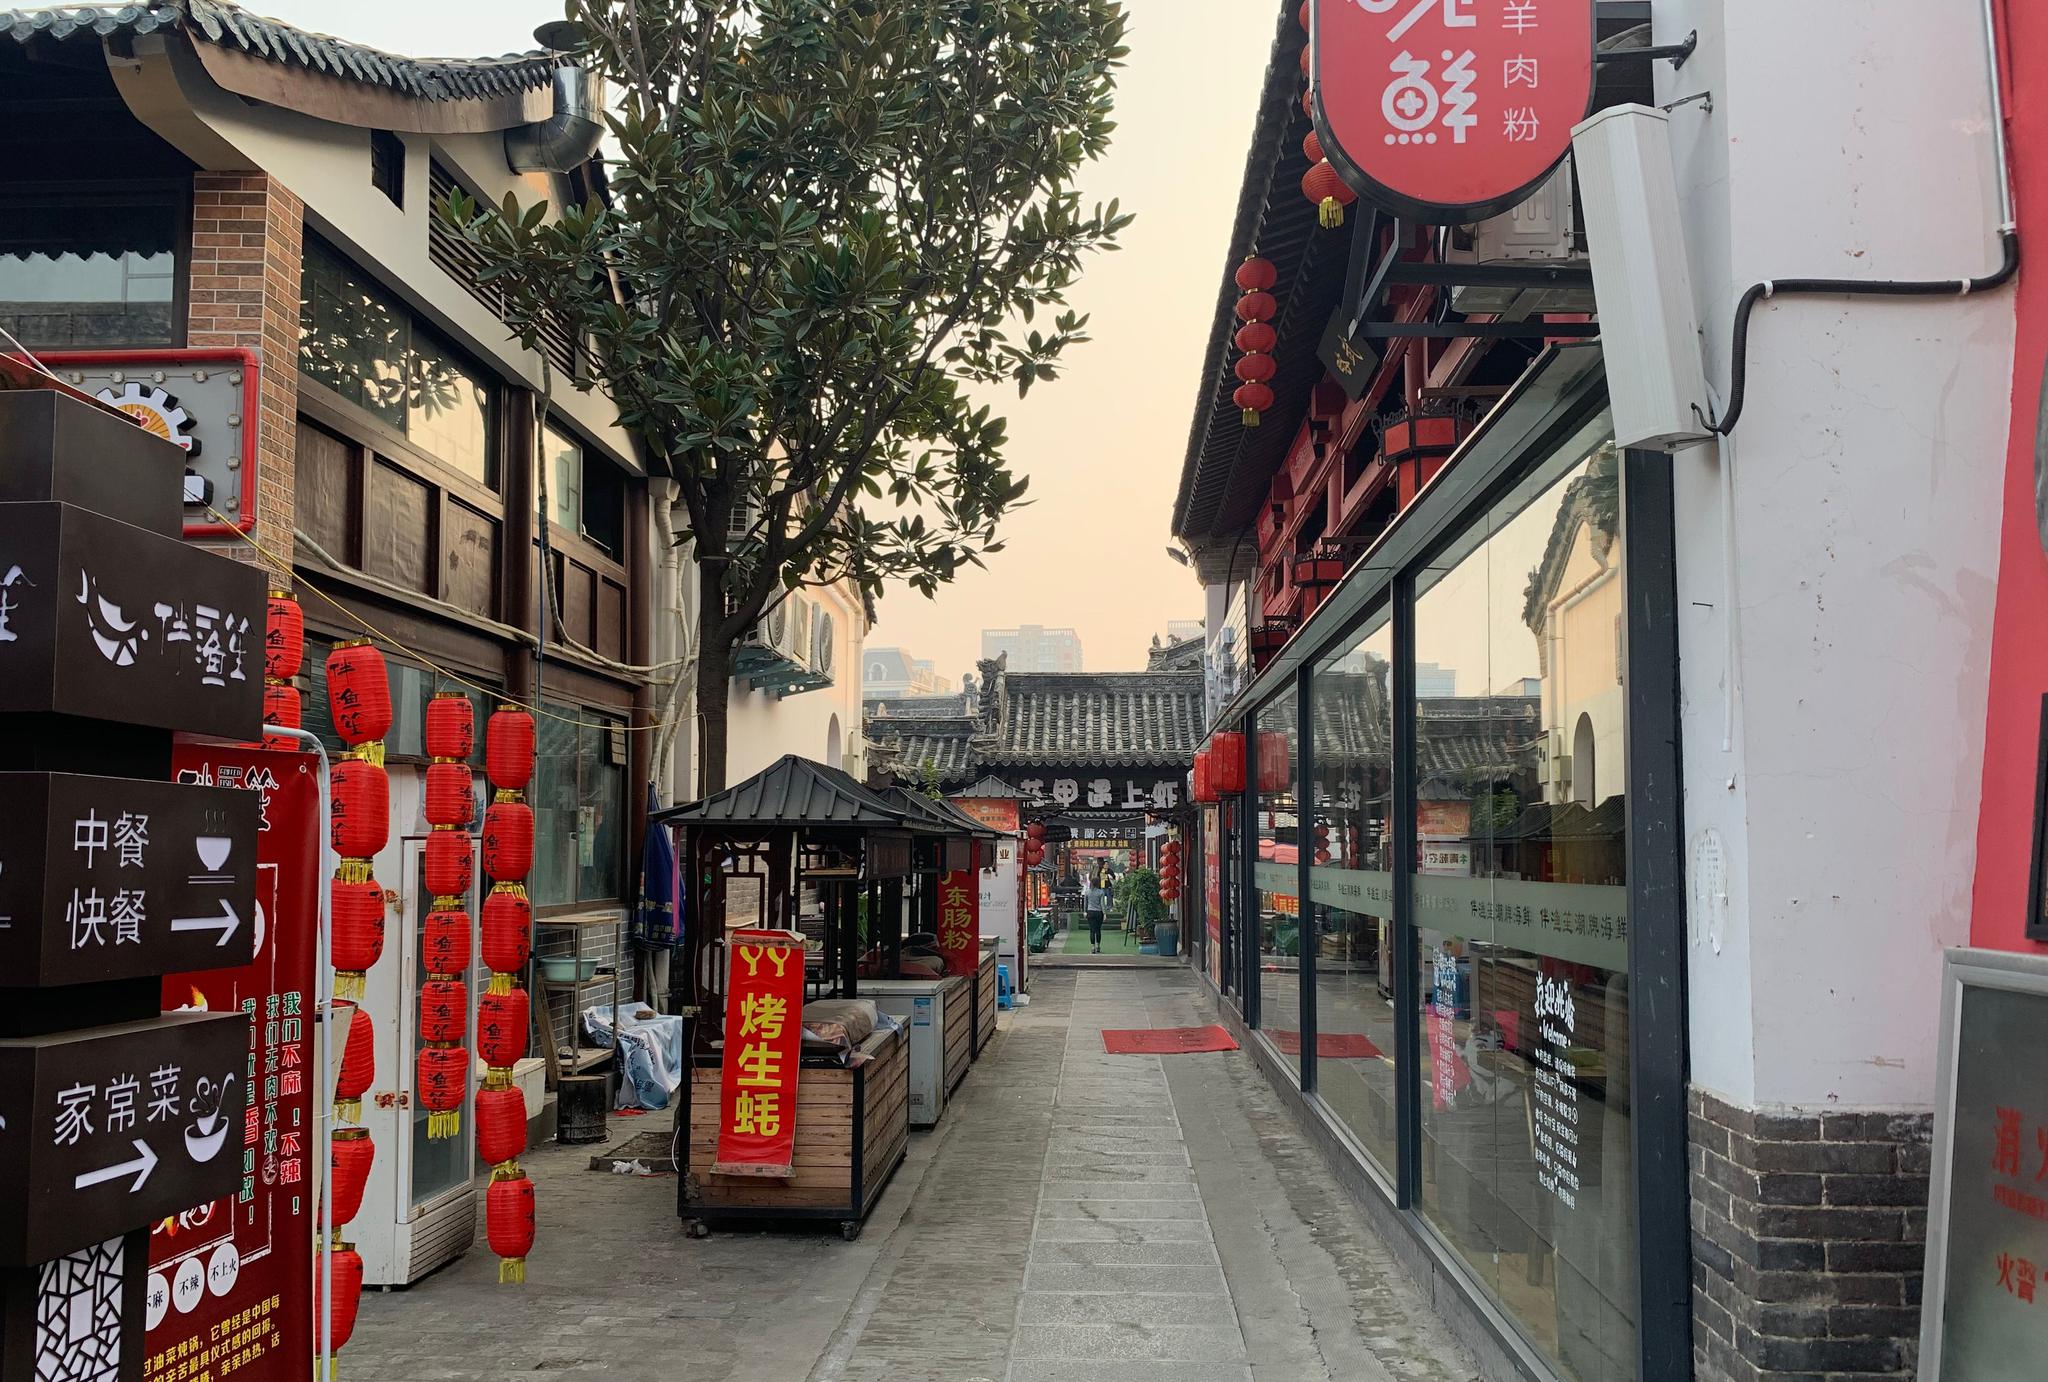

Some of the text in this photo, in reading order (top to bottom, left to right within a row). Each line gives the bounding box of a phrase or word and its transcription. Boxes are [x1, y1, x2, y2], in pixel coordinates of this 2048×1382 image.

[1502, 0, 1539, 142] 羊肉粉
[74, 808, 149, 869] 中餐
[66, 887, 146, 949] 快餐
[1534, 970, 1576, 1033] 欢迎光临
[264, 994, 280, 1156] 我们无肉不欢
[733, 992, 787, 1137] 烤生蚝
[53, 1063, 182, 1146] 家常菜
[179, 1274, 199, 1296] 不辣
[210, 1257, 237, 1282] 不上火
[1995, 1252, 2048, 1304] 火警
